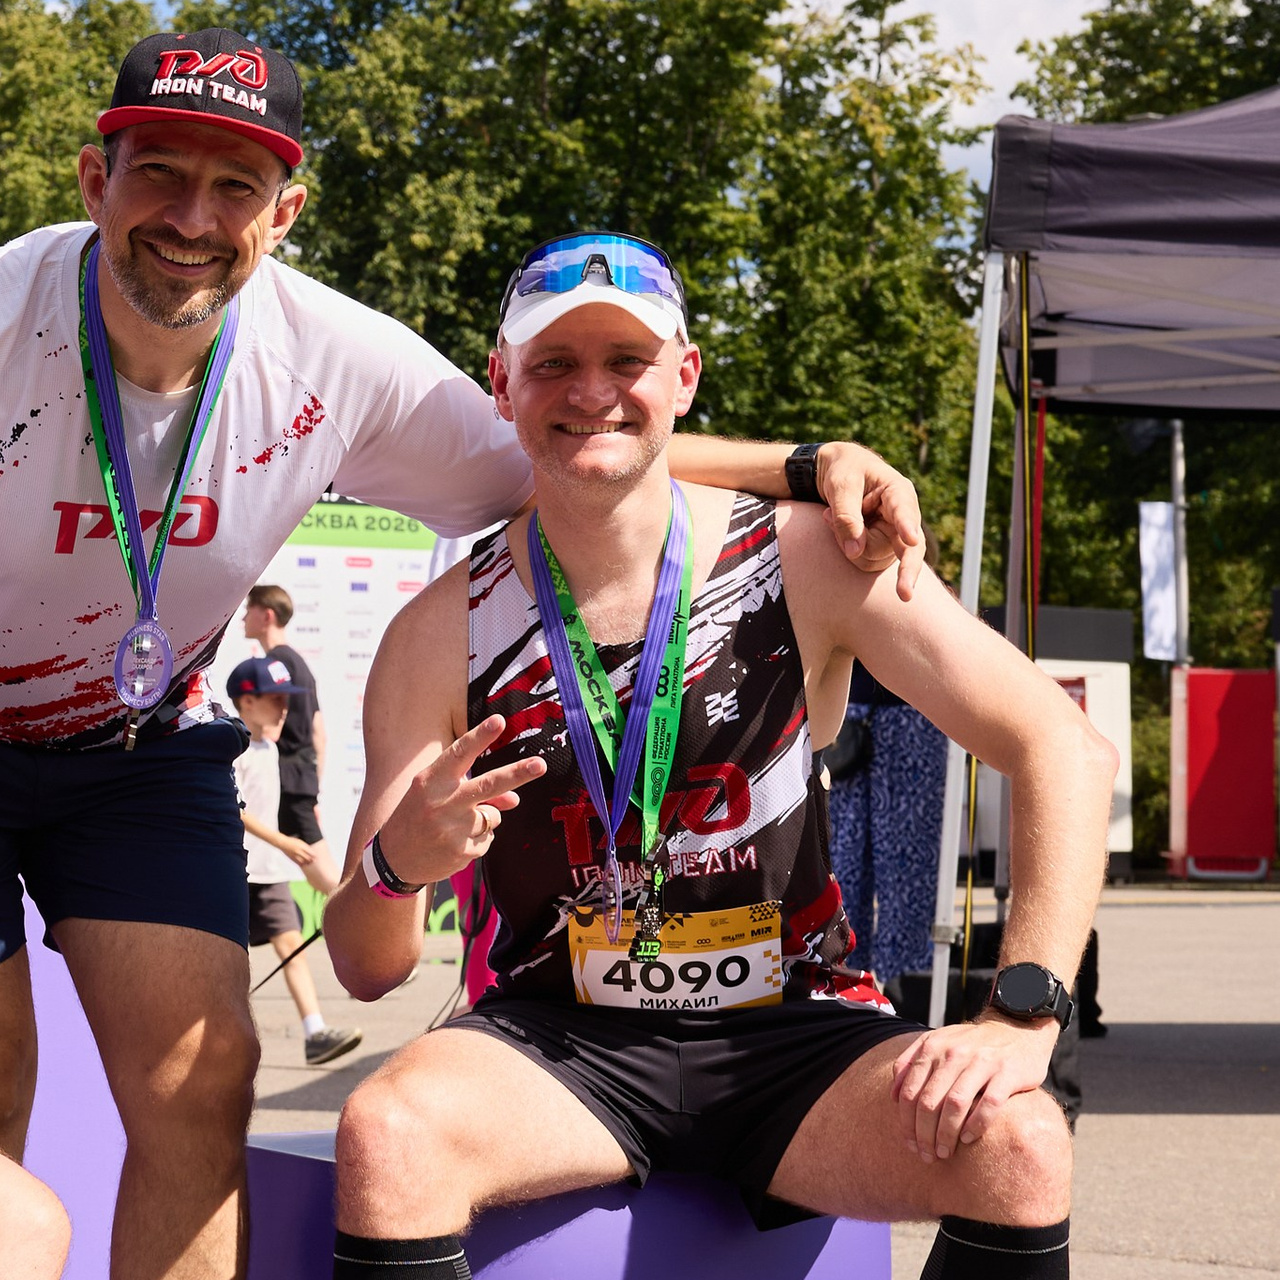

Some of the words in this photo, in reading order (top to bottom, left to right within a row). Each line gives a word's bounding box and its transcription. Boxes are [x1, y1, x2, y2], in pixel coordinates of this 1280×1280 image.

[150, 78, 204, 96] IRON
[208, 81, 268, 116] TEAM
[365, 514, 420, 533] 2026
[153, 626, 166, 641] STAR
[569, 639, 621, 752] МОСКВА
[652, 716, 661, 759] ФЕДЕРАЦИЯ
[658, 717, 667, 759] ТРИАТЛОНА
[664, 732, 672, 760] РОССИИ
[668, 844, 758, 880] TEAM
[636, 940, 661, 956] 113
[602, 955, 751, 994] 4090
[639, 996, 719, 1010] МИХАИЛ
